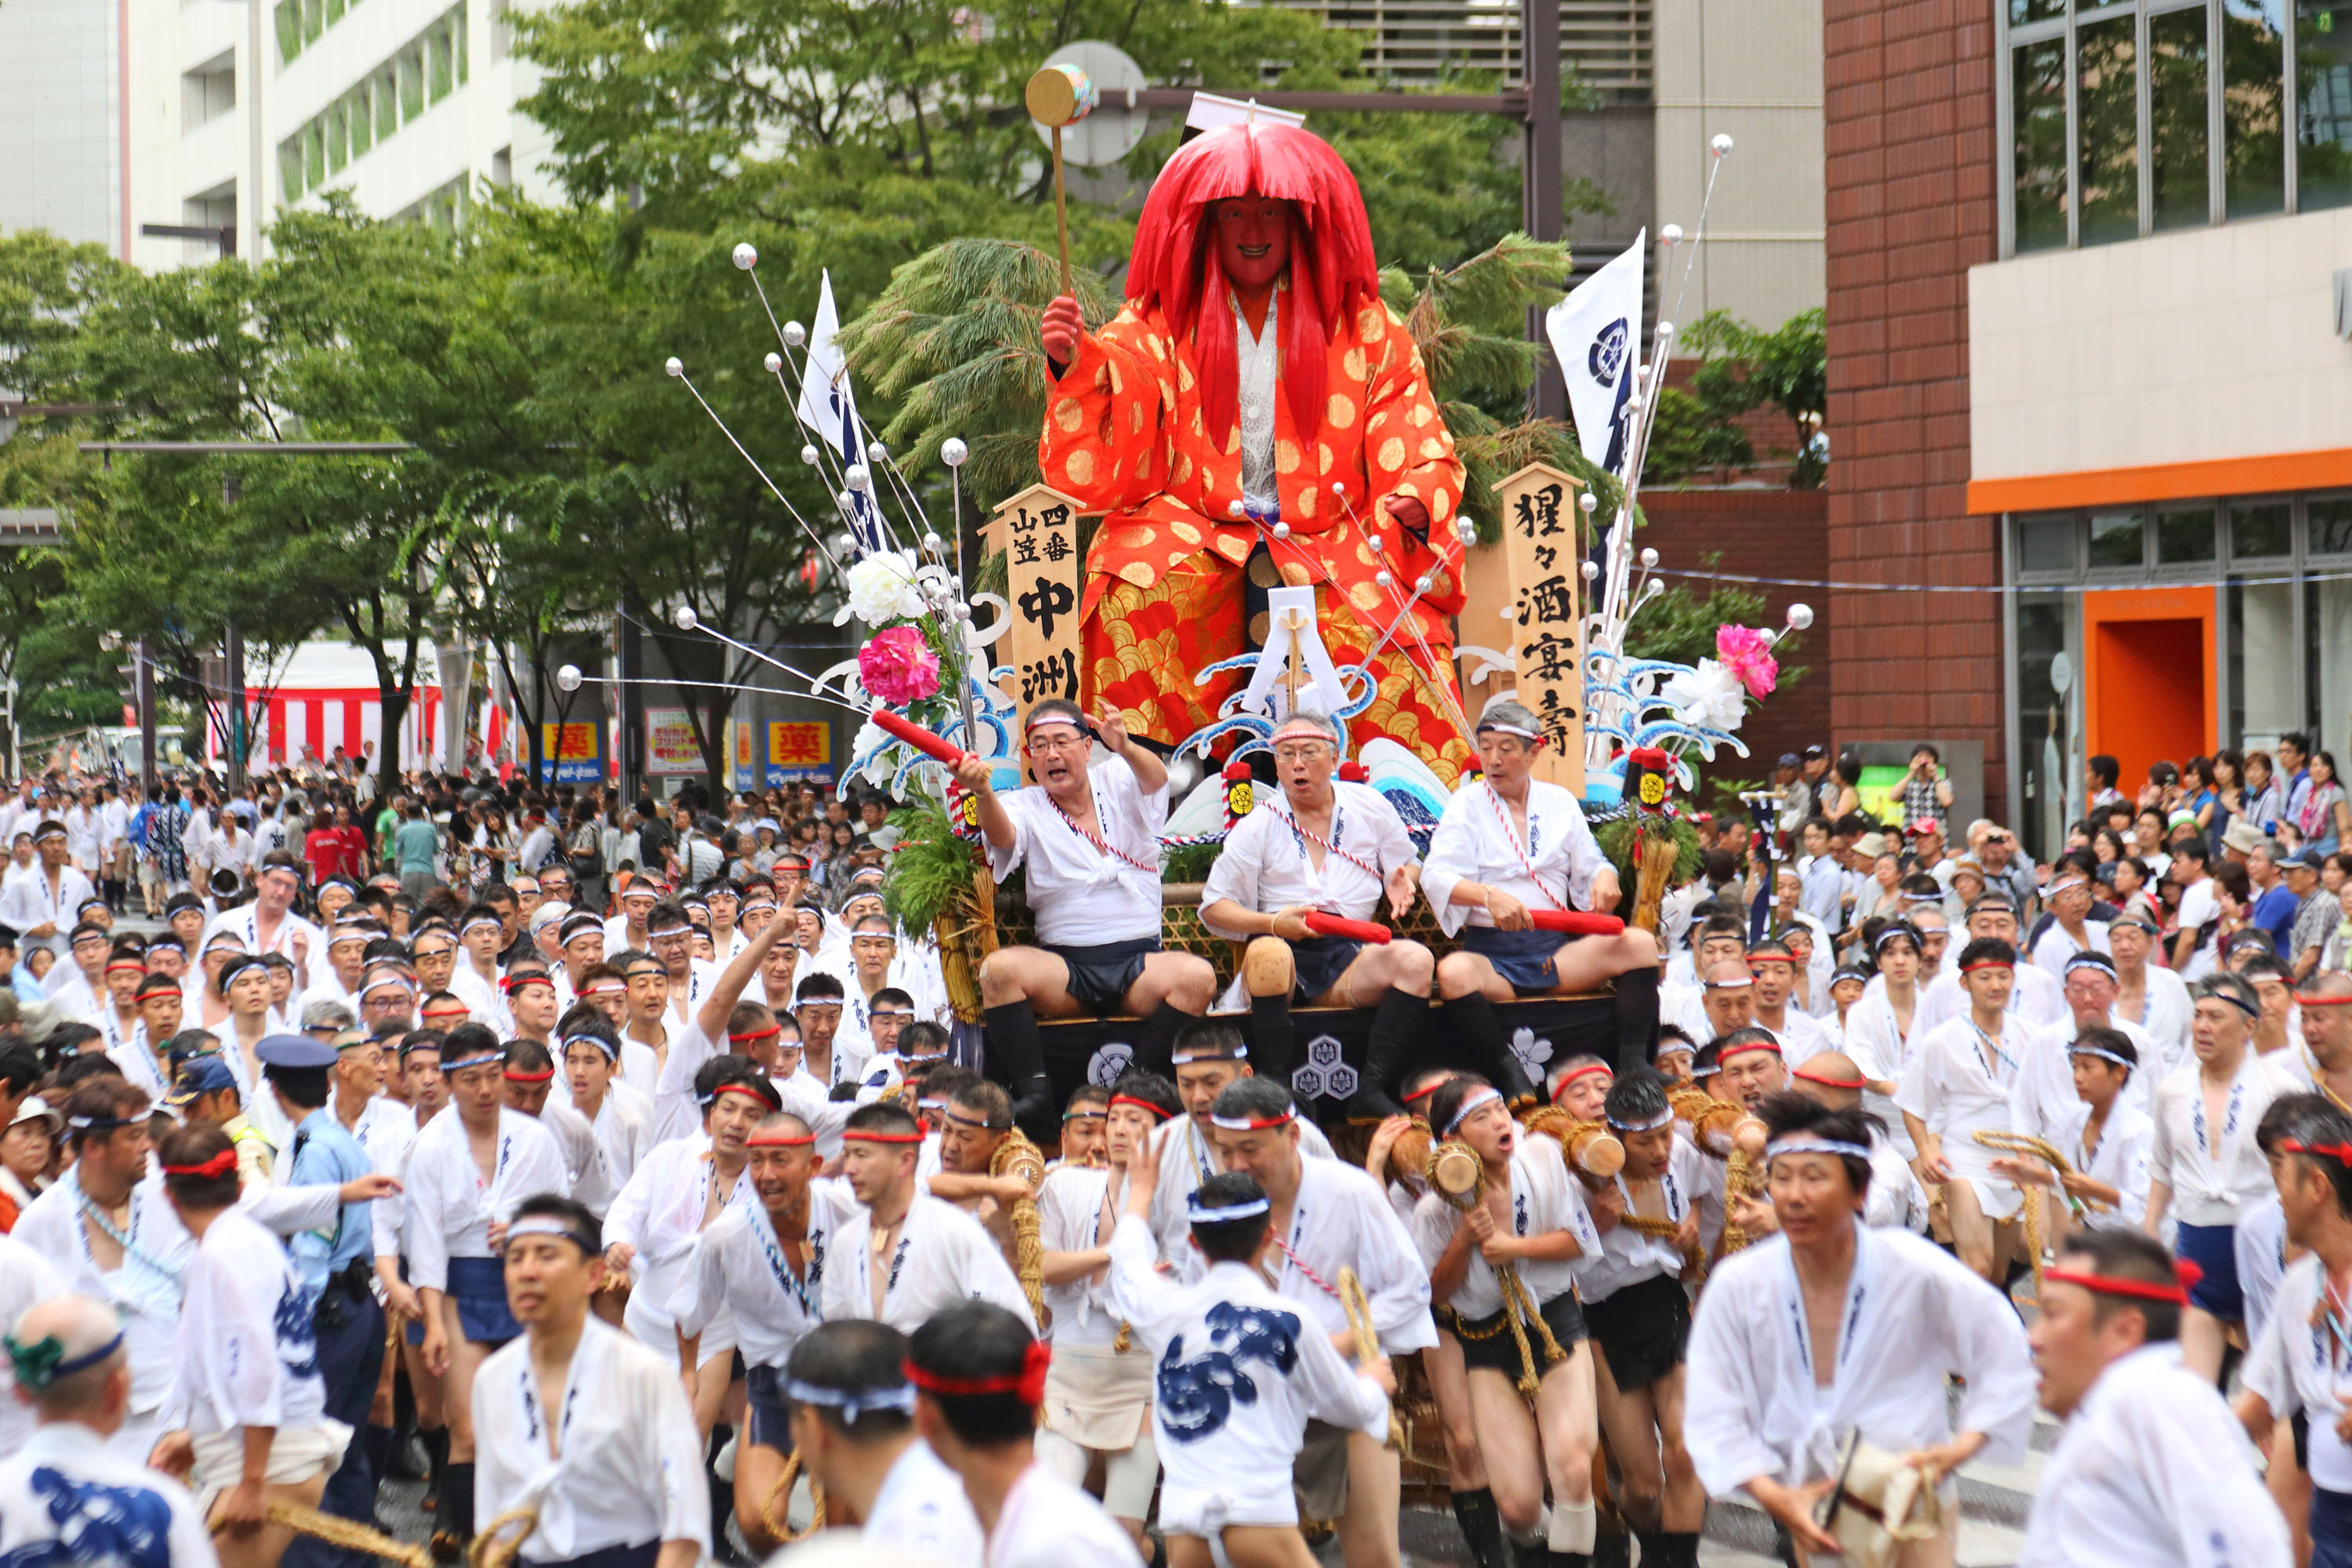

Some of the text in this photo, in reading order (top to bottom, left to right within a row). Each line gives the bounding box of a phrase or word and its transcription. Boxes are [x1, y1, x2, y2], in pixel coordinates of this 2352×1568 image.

[1010, 507, 1041, 565] 山笠
[1040, 503, 1074, 562] 四番
[1018, 576, 1079, 704] 中洲
[551, 724, 589, 758] 薬
[778, 724, 821, 762] 薬
